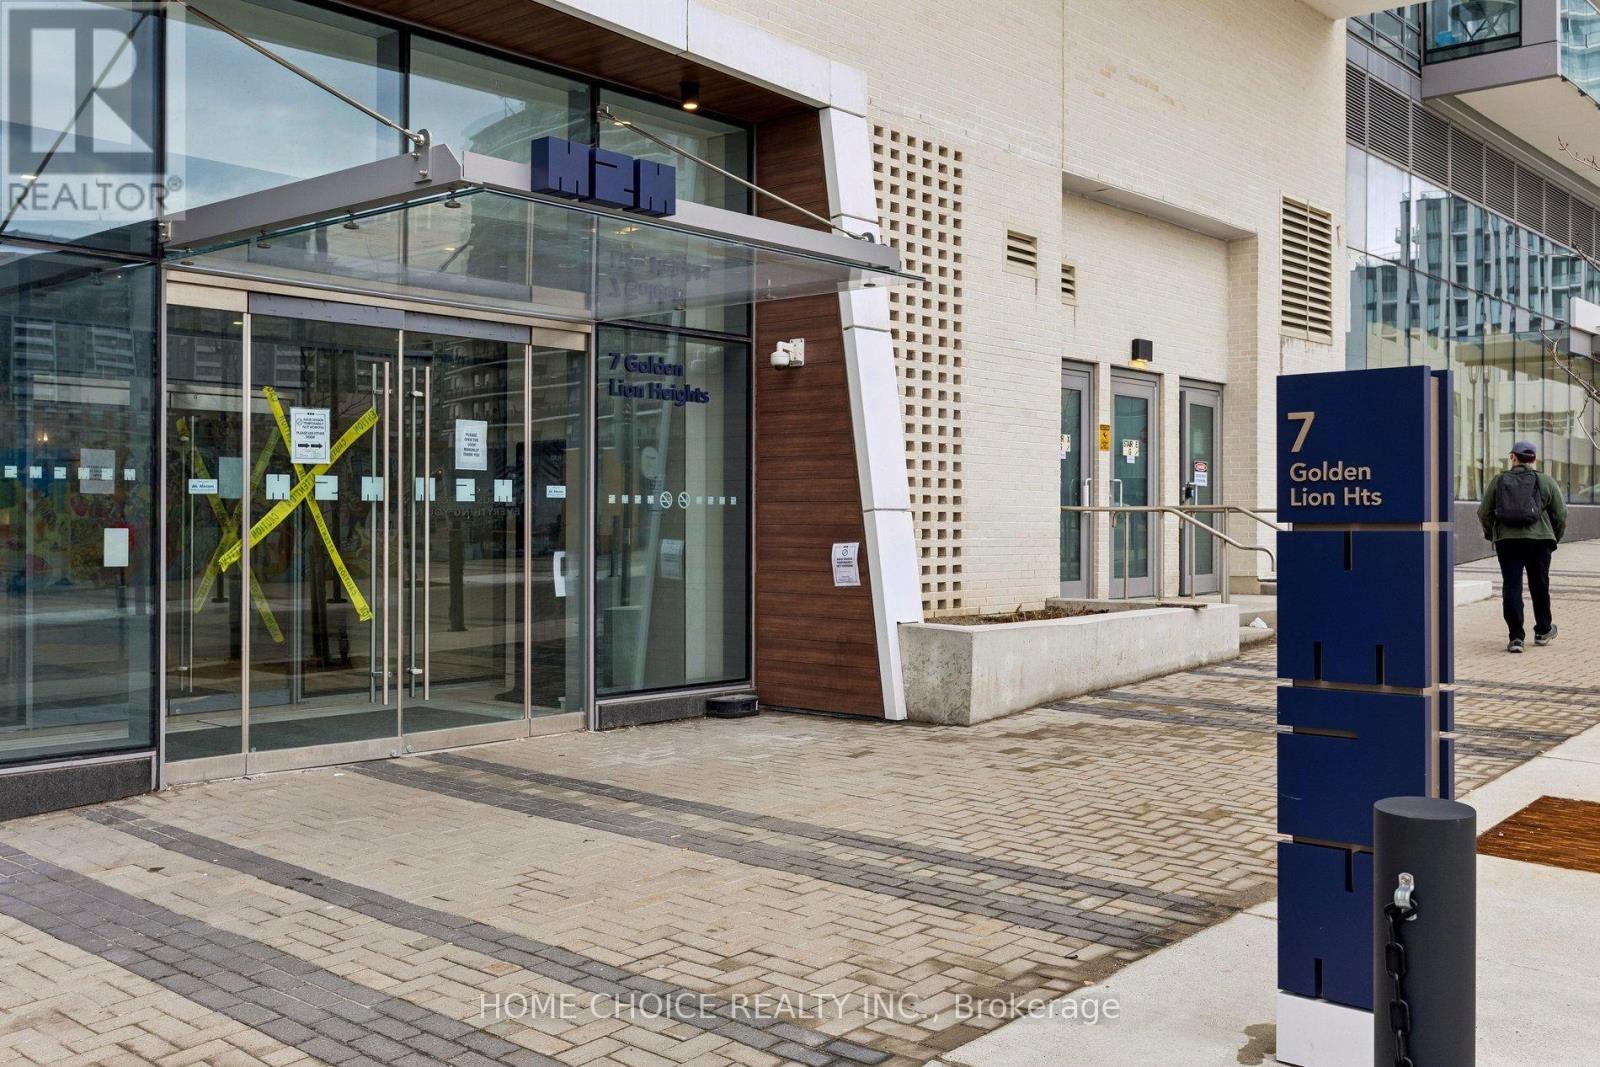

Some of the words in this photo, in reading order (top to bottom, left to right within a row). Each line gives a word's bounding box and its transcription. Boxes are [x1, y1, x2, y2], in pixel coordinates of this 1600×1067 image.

[608, 352, 621, 371] 7
[624, 354, 684, 377] Golden
[608, 378, 644, 399] Lion
[648, 381, 711, 407] Heights
[1287, 411, 1316, 453] 7
[1289, 460, 1372, 482] Golden
[1290, 487, 1336, 507] Lion
[1343, 486, 1383, 507] Hts
